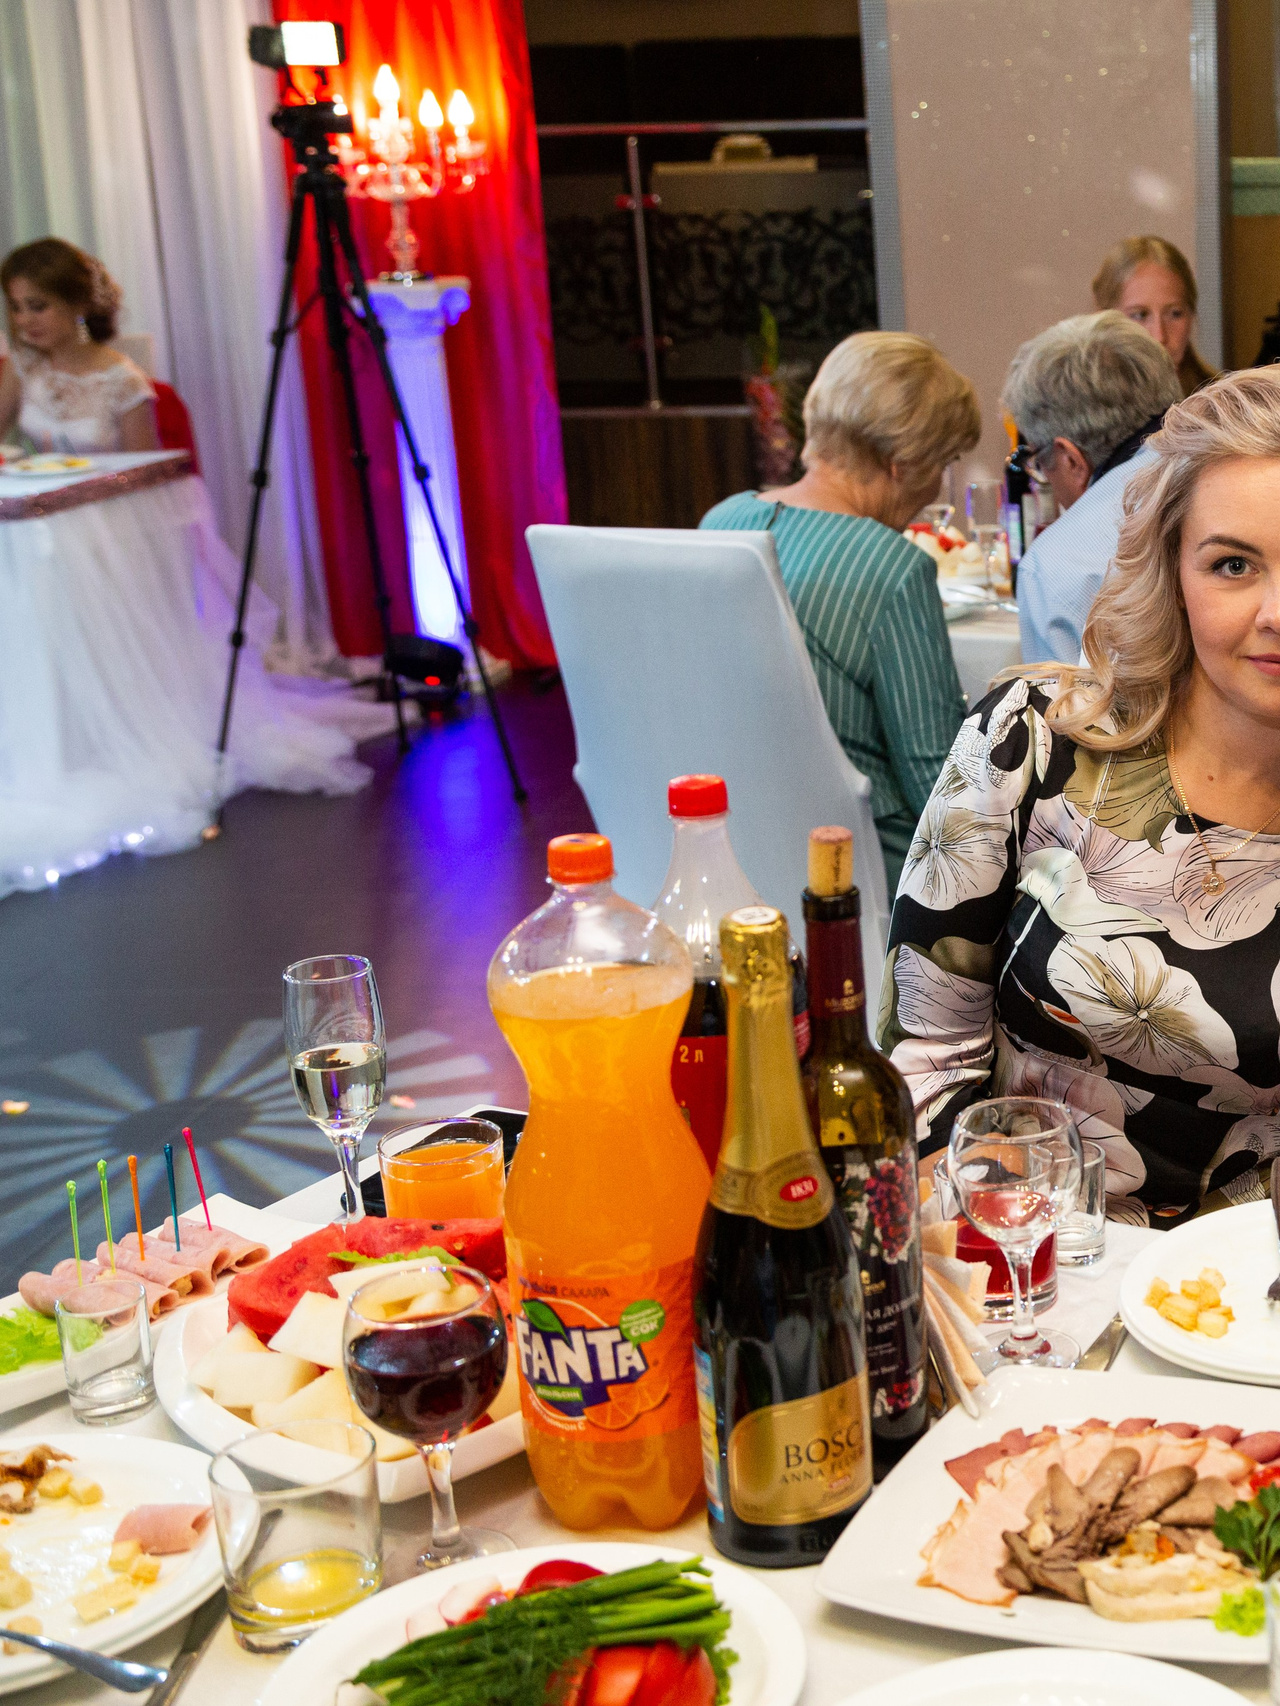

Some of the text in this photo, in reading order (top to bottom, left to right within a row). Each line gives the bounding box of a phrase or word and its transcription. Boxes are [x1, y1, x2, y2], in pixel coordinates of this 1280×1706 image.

[679, 1045, 689, 1062] 2
[515, 1316, 647, 1385] FANTA
[784, 1420, 861, 1469] BOSC
[780, 1468, 825, 1485] ANNA
